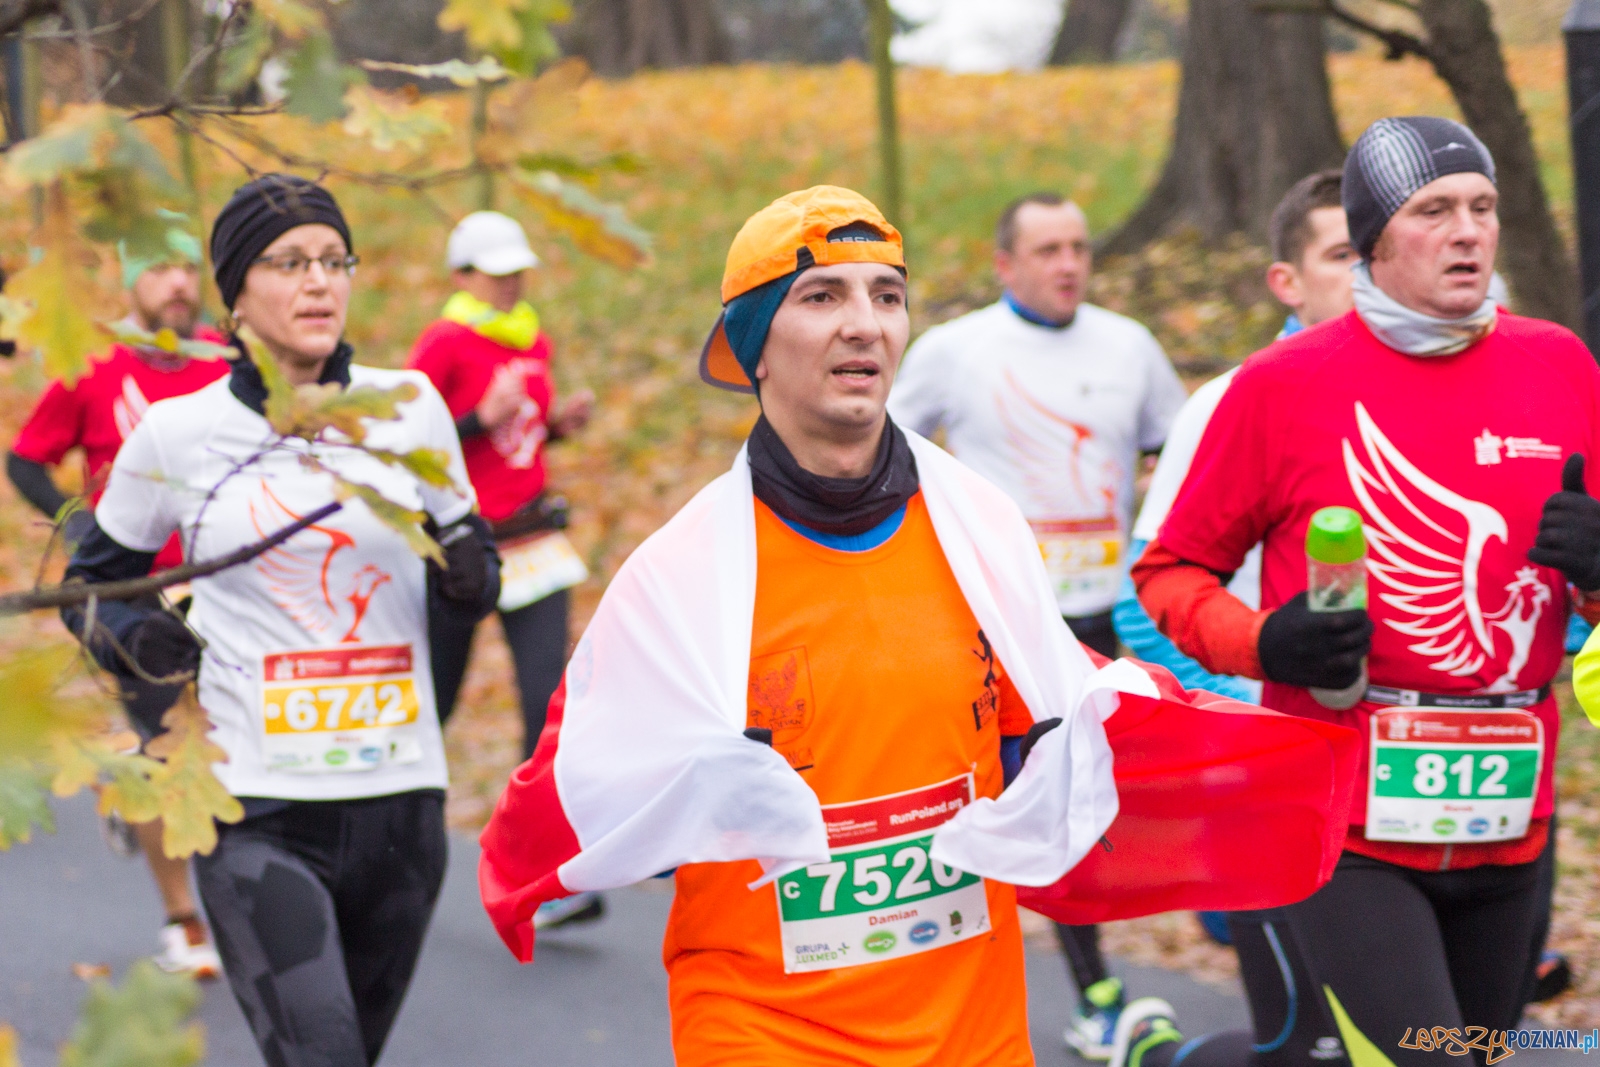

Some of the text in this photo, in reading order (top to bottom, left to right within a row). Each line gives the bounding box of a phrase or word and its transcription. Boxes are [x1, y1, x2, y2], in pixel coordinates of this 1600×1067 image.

[284, 683, 407, 731] 6742
[1376, 753, 1509, 796] C 812
[889, 797, 964, 825] RunPoland.org
[783, 846, 963, 912] C 7520
[868, 908, 918, 926] Damian
[795, 943, 830, 955] GRUPA
[795, 951, 838, 964] LUXMED
